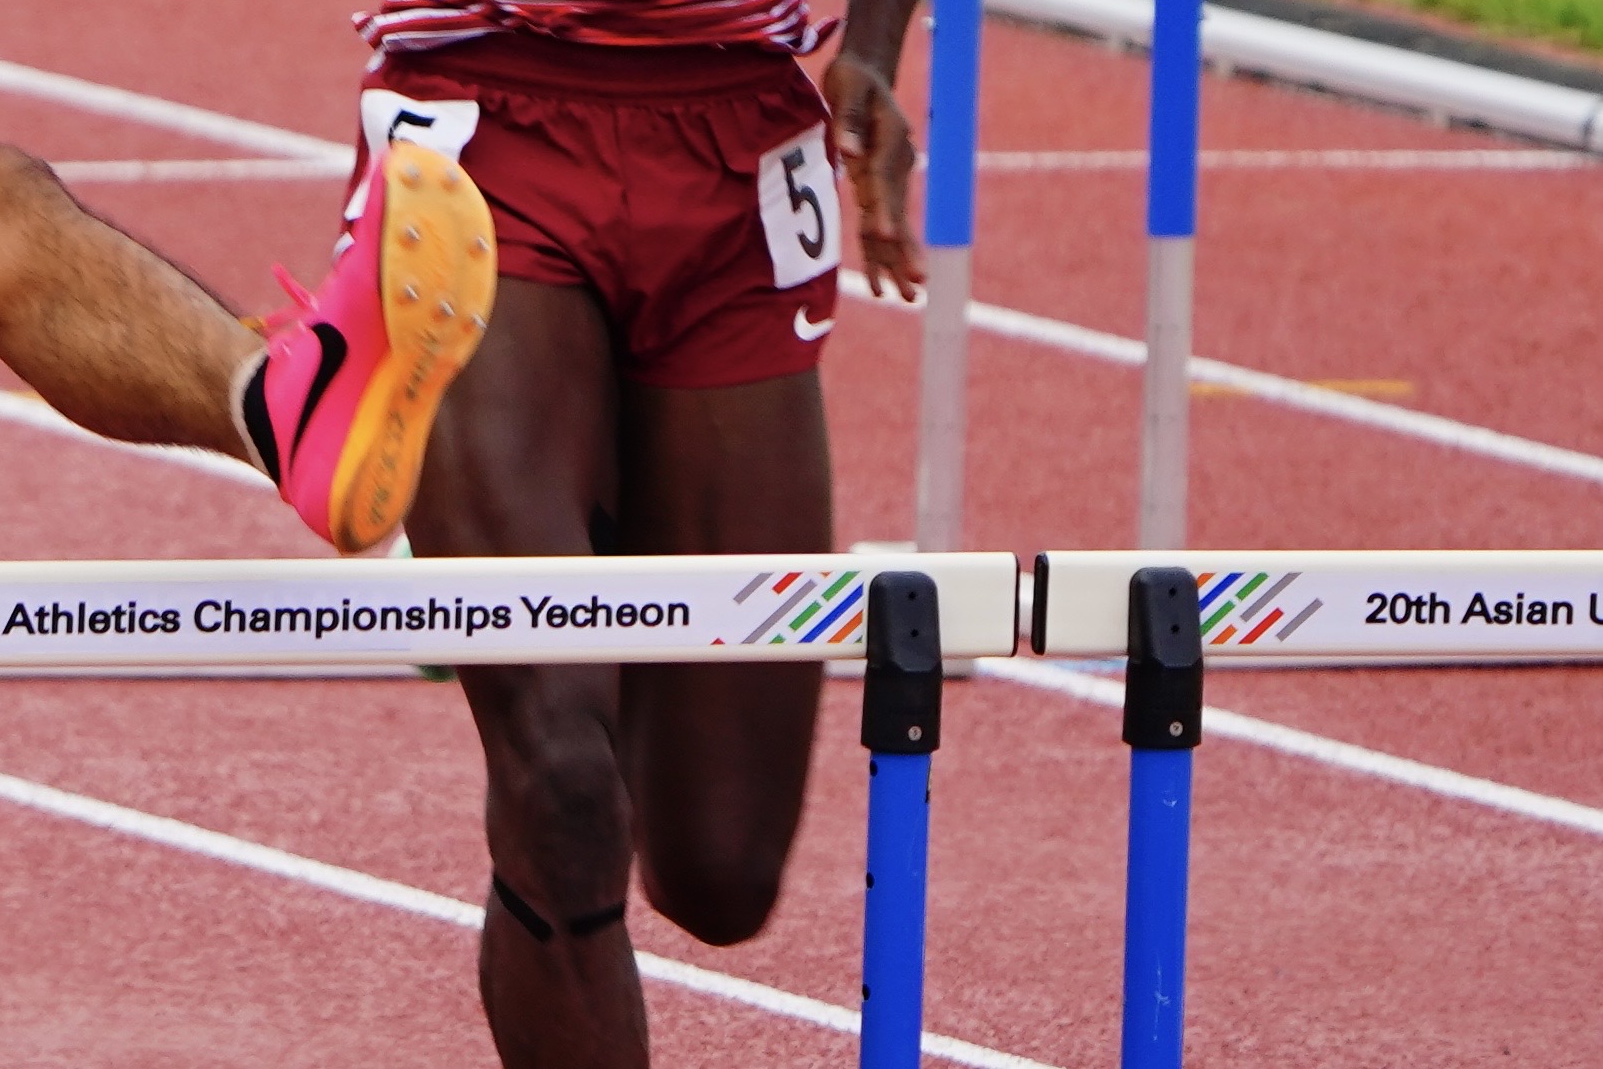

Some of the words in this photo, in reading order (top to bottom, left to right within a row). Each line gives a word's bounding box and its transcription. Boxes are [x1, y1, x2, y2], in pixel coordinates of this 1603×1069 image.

[781, 146, 827, 261] 5
[1, 601, 181, 635] Athletics
[193, 597, 512, 639] Championships
[520, 595, 690, 629] Yecheon
[1365, 592, 1451, 625] 20th
[1460, 592, 1574, 626] Asian
